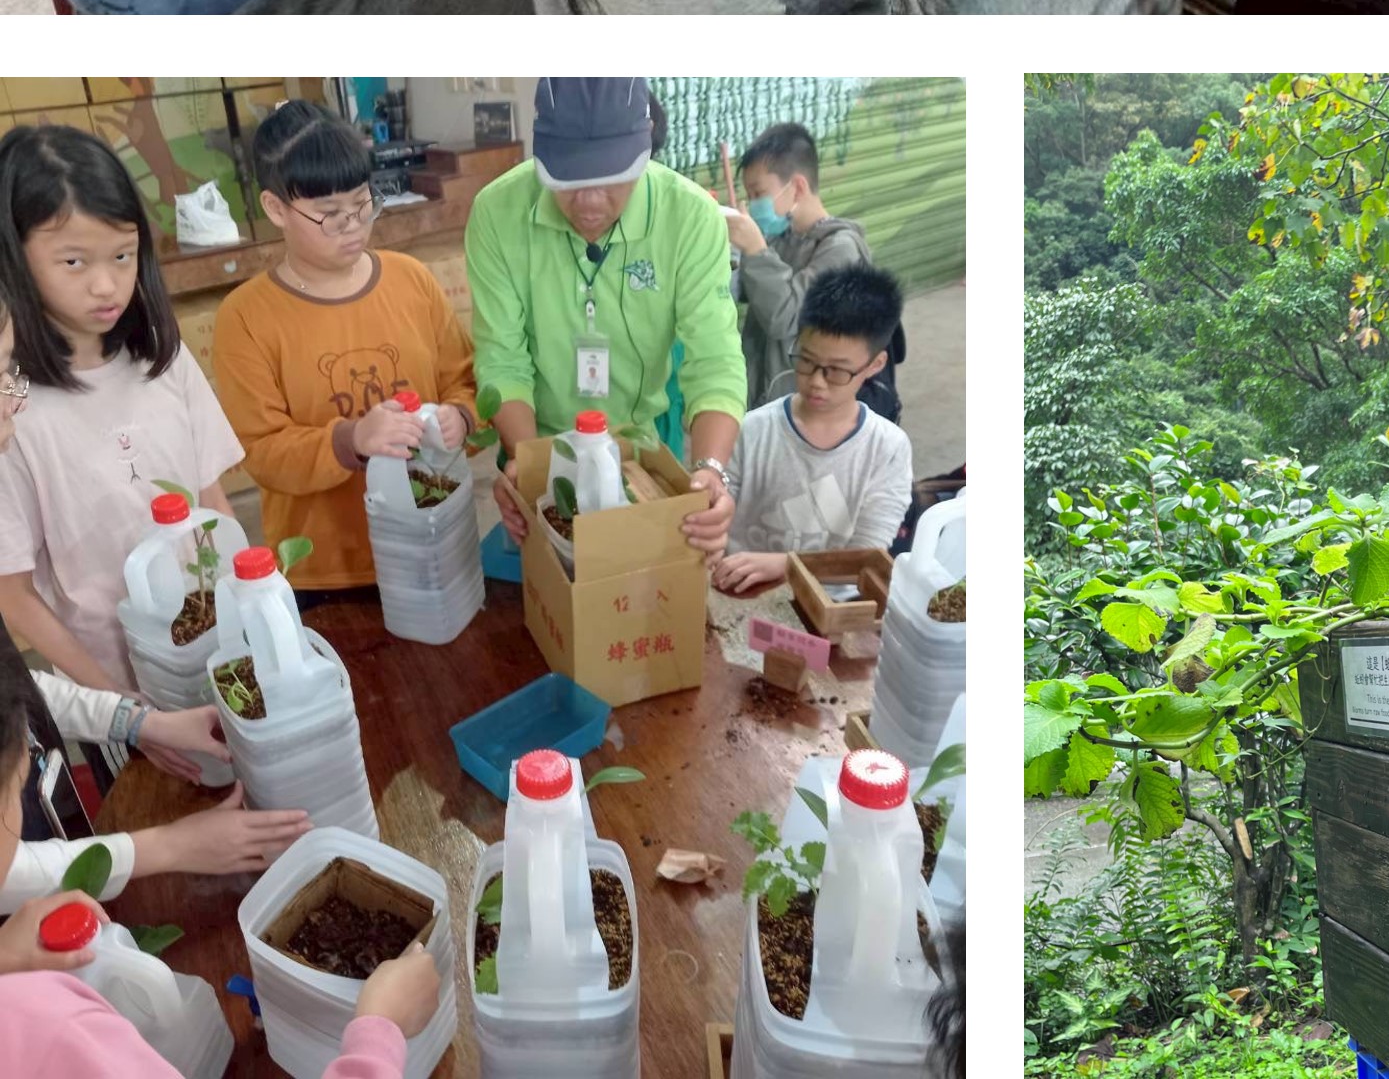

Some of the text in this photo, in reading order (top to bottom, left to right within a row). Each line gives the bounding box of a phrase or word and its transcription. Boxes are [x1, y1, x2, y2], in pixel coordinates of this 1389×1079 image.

[1367, 694, 1376, 702] This
[1378, 695, 1381, 703] is
[1382, 696, 1389, 705] the
[1381, 709, 1389, 717] food
